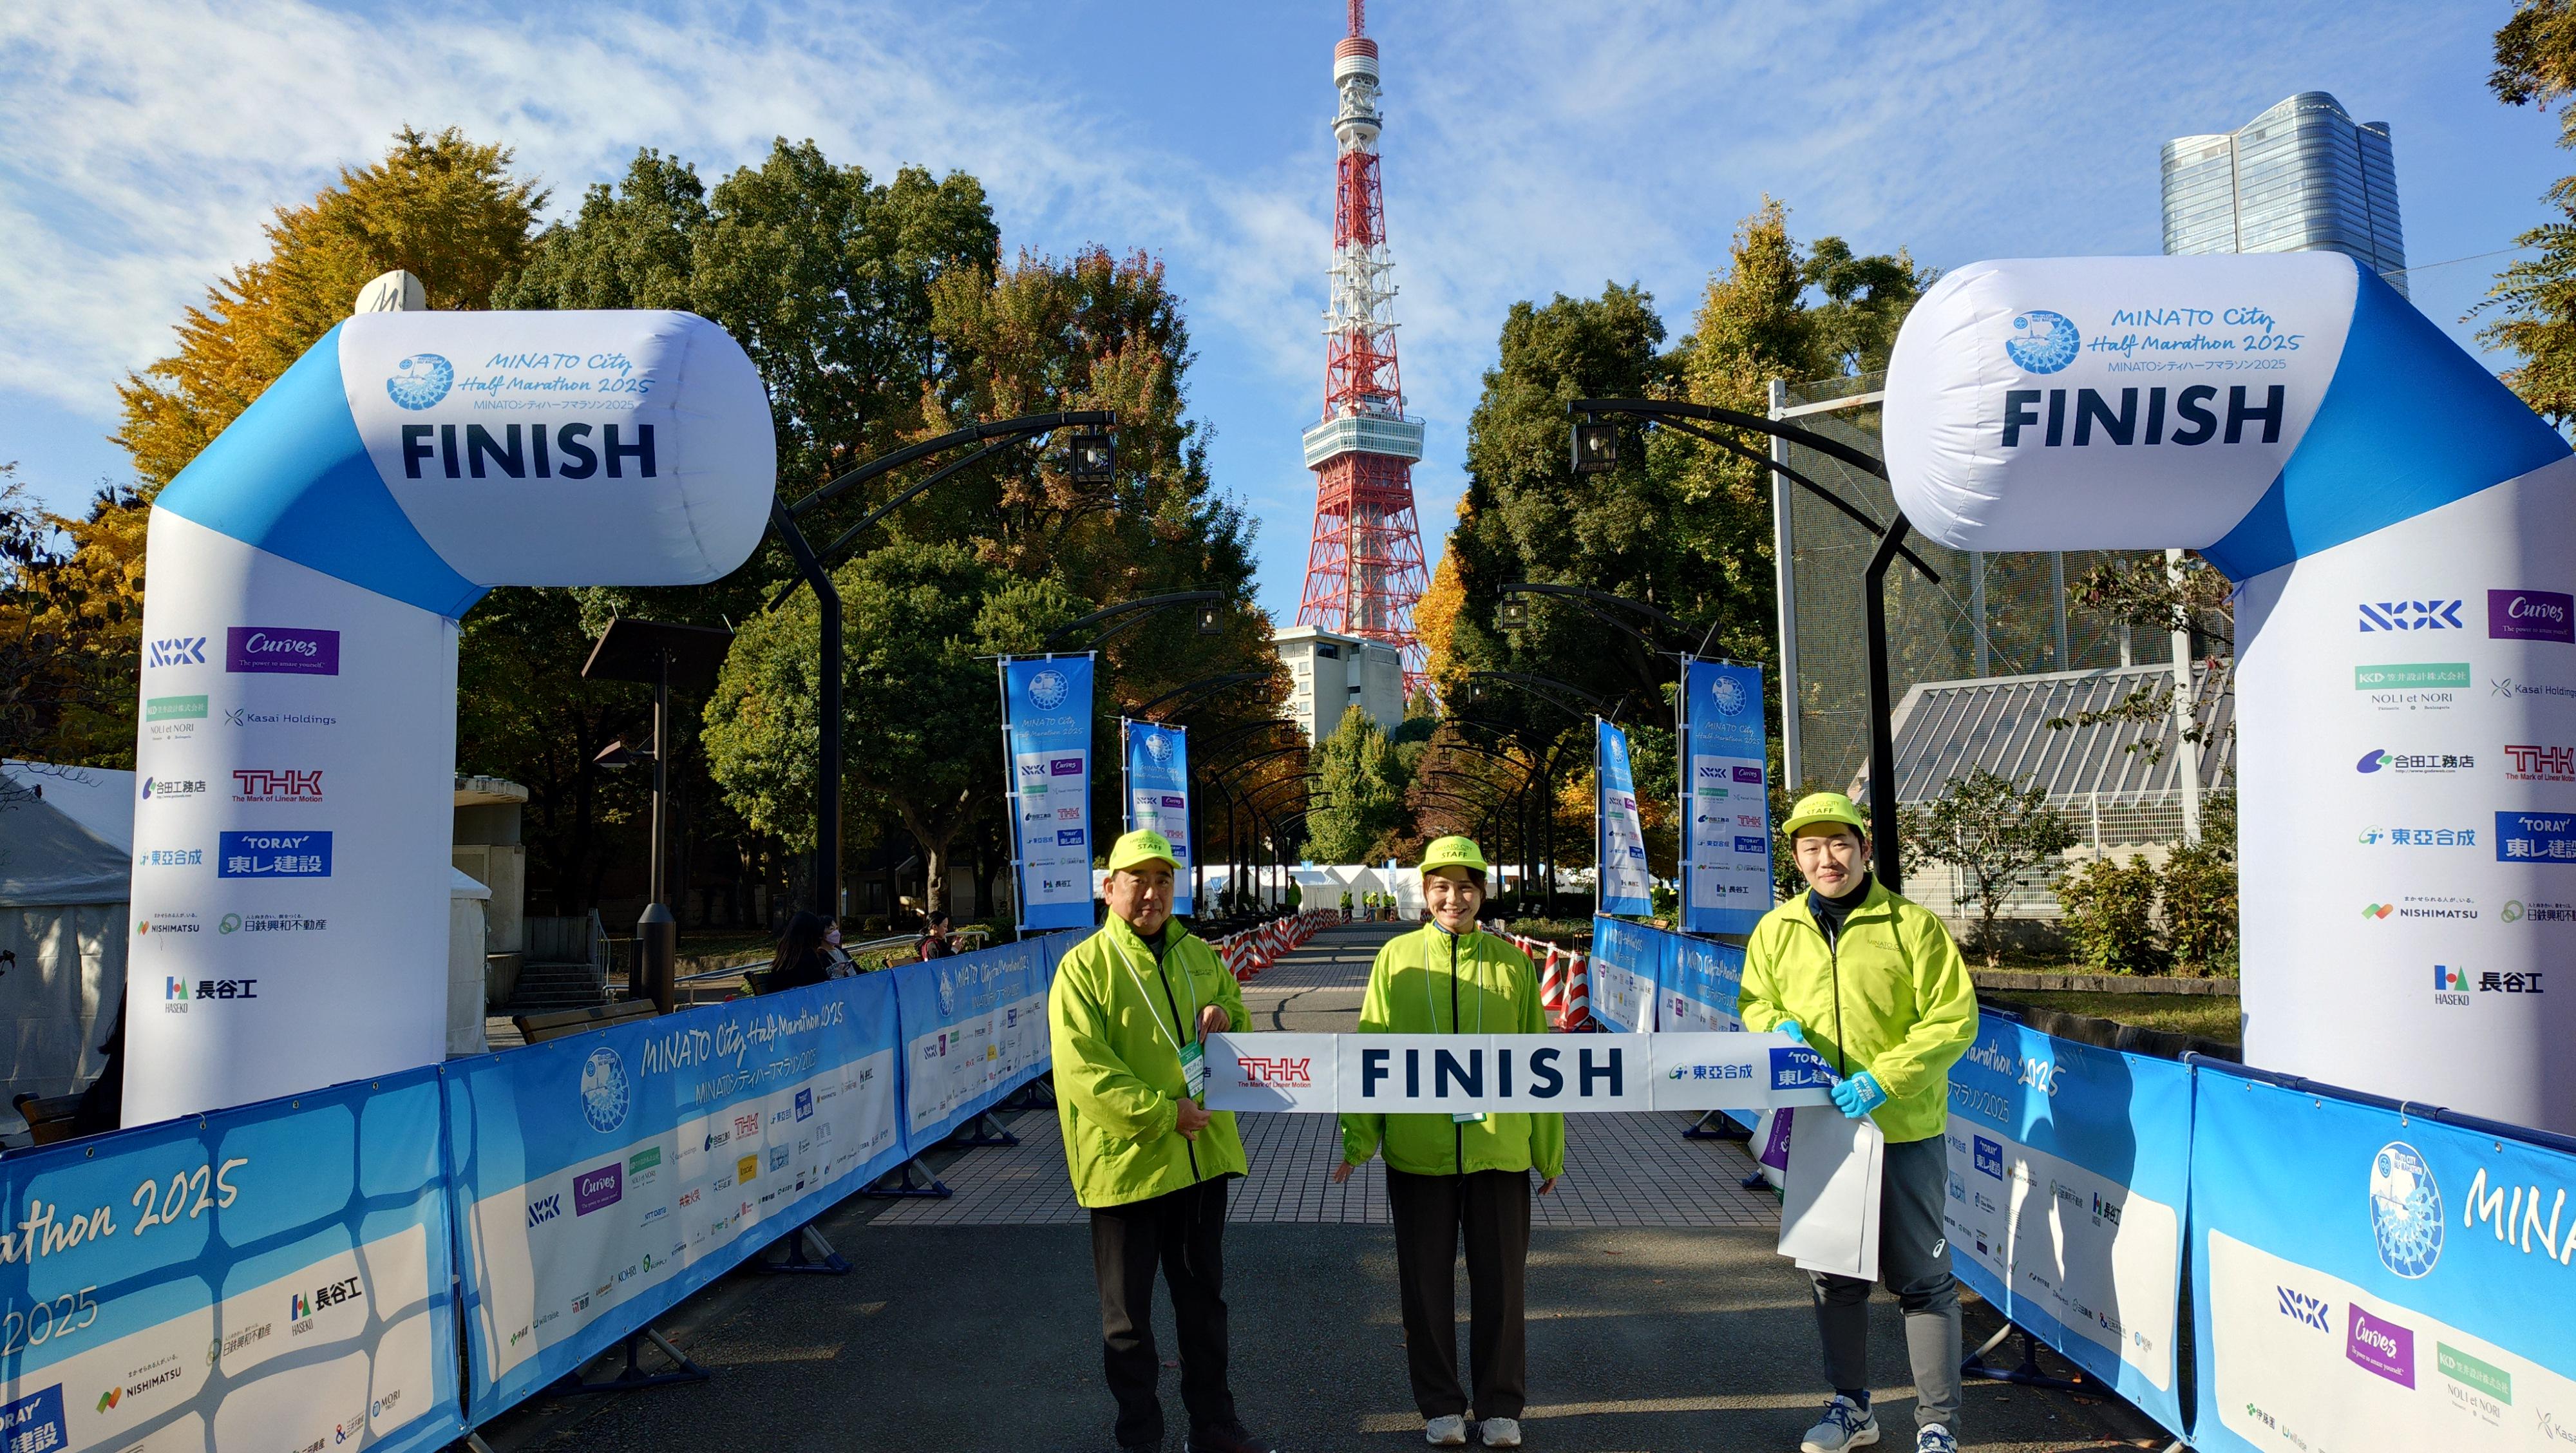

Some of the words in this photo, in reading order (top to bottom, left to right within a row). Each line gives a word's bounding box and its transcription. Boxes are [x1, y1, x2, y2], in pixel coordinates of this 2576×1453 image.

[2111, 308, 2213, 327] MINATO
[2223, 307, 2275, 333] City
[2087, 335, 2139, 358] Half
[2141, 334, 2235, 350] Marathon
[2242, 334, 2305, 351] 2025
[486, 353, 580, 370] MINATO
[587, 353, 632, 376] City
[2108, 359, 2286, 372] MINATOシティハーフマラソン2025
[458, 375, 504, 397] Half
[506, 378, 591, 390] Marathon
[598, 379, 656, 393] 2025
[474, 400, 634, 410] MINATOシティハーフマラソン2025
[2002, 385, 2285, 448] FINISH
[402, 423, 657, 479] FINISH
[2360, 600, 2462, 632] NOK
[2508, 596, 2564, 622] Curves
[150, 637, 206, 668] NOK
[246, 633, 317, 656] Curves
[2372, 694, 2403, 703] NOLI
[2421, 693, 2452, 703] NORI
[2515, 685, 2543, 694] Kasai
[2545, 685, 2576, 698] Holdings
[247, 714, 279, 723] Kasai
[283, 714, 336, 725] Holdings
[1705, 721, 1736, 732] MINATO
[1739, 725, 1754, 737] City
[2394, 755, 2474, 768] 合田工務店
[2505, 745, 2575, 774] THK
[156, 780, 205, 794] 合田工務店
[233, 770, 323, 795] THK
[1057, 808, 1079, 818] THK
[1738, 815, 1761, 826] THK
[2391, 828, 2476, 846] 東亞合成
[151, 849, 202, 866] 東亞合成
[227, 856, 322, 873] 東レ建設
[2400, 909, 2477, 919] NISHIMATSU
[152, 924, 199, 933] NISHIMATSU
[245, 919, 327, 932] 日鉄興和不動産
[196, 980, 257, 1000] 長谷工
[2479, 972, 2544, 993] 長谷工
[166, 1003, 188, 1013] HASEKO
[2435, 994, 2469, 1005] HASEKO
[641, 1029, 711, 1078] MINATO
[716, 1019, 747, 1069] City
[747, 1012, 778, 1052] Half
[778, 1006, 819, 1038] Marathon
[1238, 1058, 1311, 1081] THK
[1362, 1048, 1623, 1098] FINISH
[1693, 1065, 1753, 1079] 東亞合成
[2017, 1056, 2067, 1097] 2025
[735, 1113, 759, 1135] THK
[582, 1175, 615, 1197] Curves
[132, 1158, 249, 1237] 2025
[529, 1193, 560, 1228] NOK
[2104, 1202, 2121, 1226] 長谷工
[618, 1265, 637, 1283] KOHRI
[315, 1277, 362, 1311] 長谷工
[2277, 1285, 2329, 1334] NOK
[292, 1318, 314, 1336] HASEKO
[2355, 1316, 2397, 1359] Curves
[223, 1323, 272, 1357] 日鉄興和不動産
[126, 1367, 182, 1398] NISHIMATSU
[381, 1389, 400, 1407] MORI
[2448, 1383, 2468, 1403] NOLI
[2470, 1396, 2477, 1407] et
[2479, 1398, 2500, 1418] NORI
